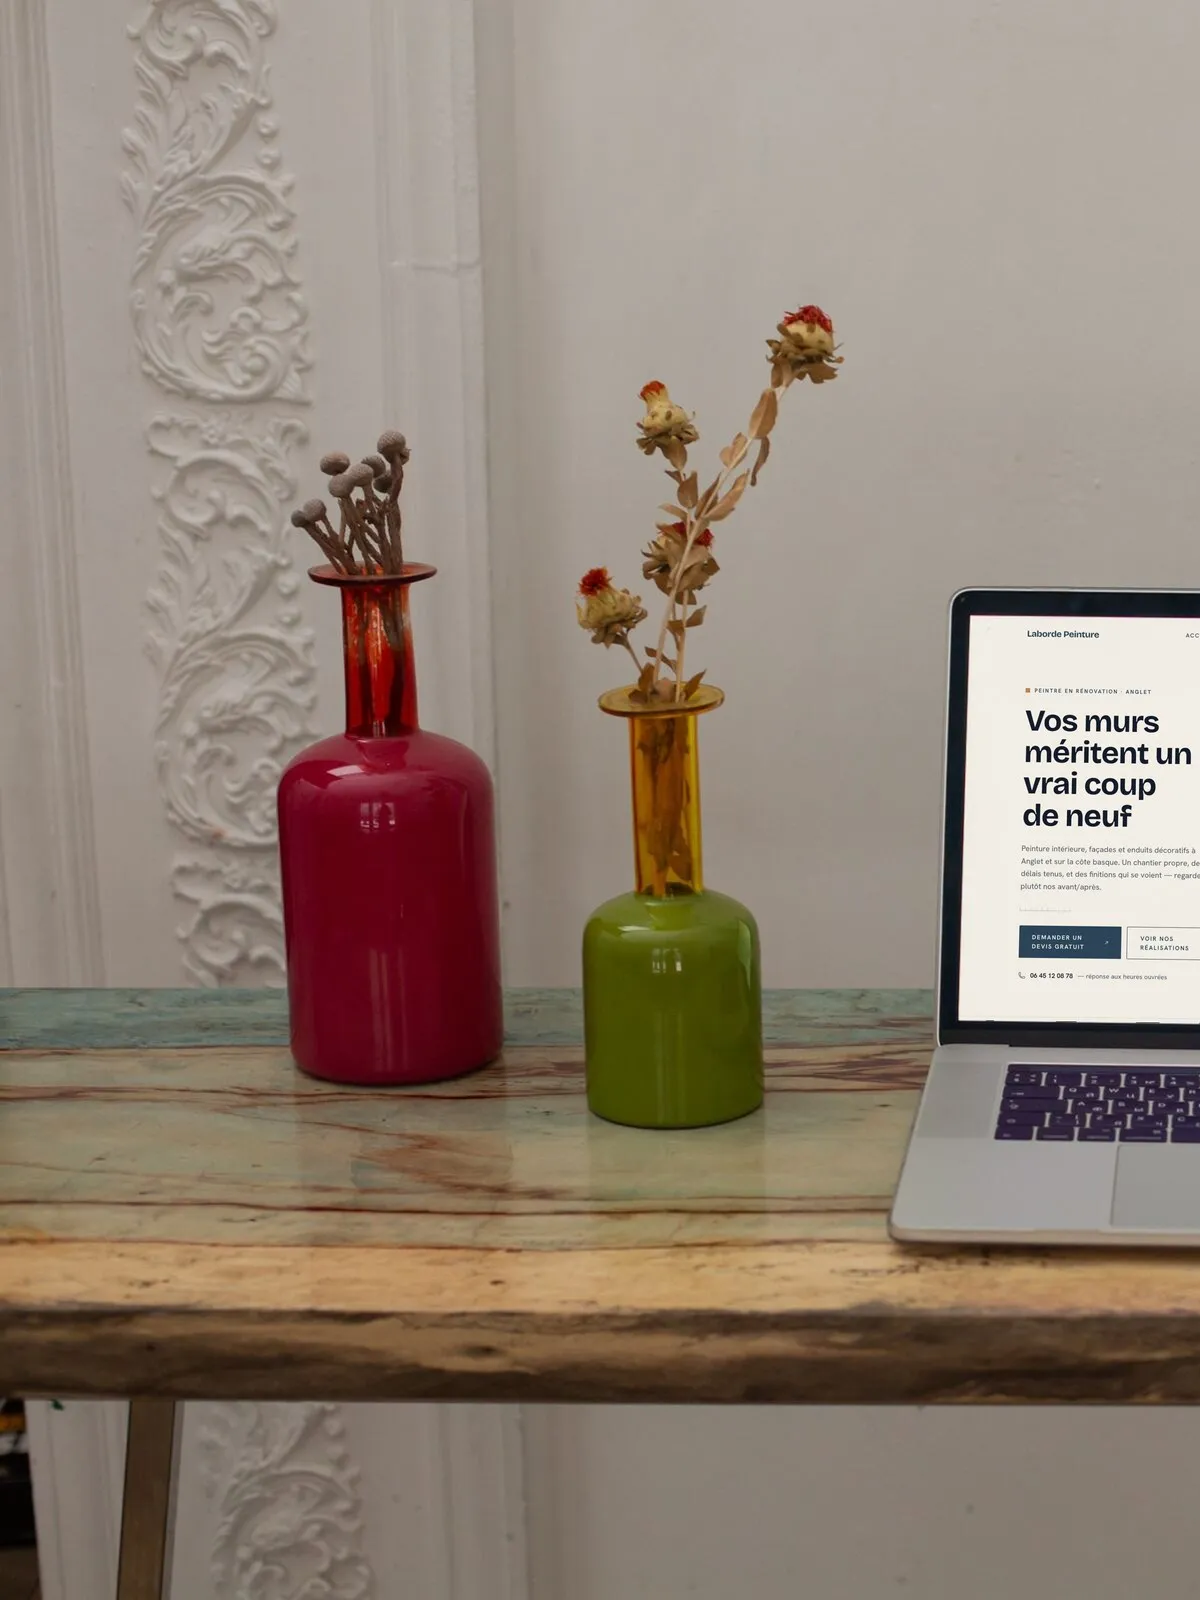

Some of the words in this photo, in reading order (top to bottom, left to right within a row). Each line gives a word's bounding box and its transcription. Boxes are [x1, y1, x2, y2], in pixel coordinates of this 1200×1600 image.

[1027, 630, 1062, 638] Laborde
[1063, 630, 1100, 639] Peinture
[1075, 686, 1118, 694] RÉNOVATION
[1025, 710, 1078, 732] Vos
[1085, 714, 1160, 733] murs
[1025, 739, 1149, 765] méritent
[1155, 746, 1192, 765] un
[1023, 771, 1078, 795] vrai
[1084, 777, 1156, 800] coup
[1023, 803, 1059, 827] de
[1066, 804, 1133, 828] neuf
[1051, 845, 1087, 853] intérieure,
[1088, 846, 1116, 854] façades
[1021, 858, 1043, 866] Anglet
[1092, 859, 1120, 867] basque.
